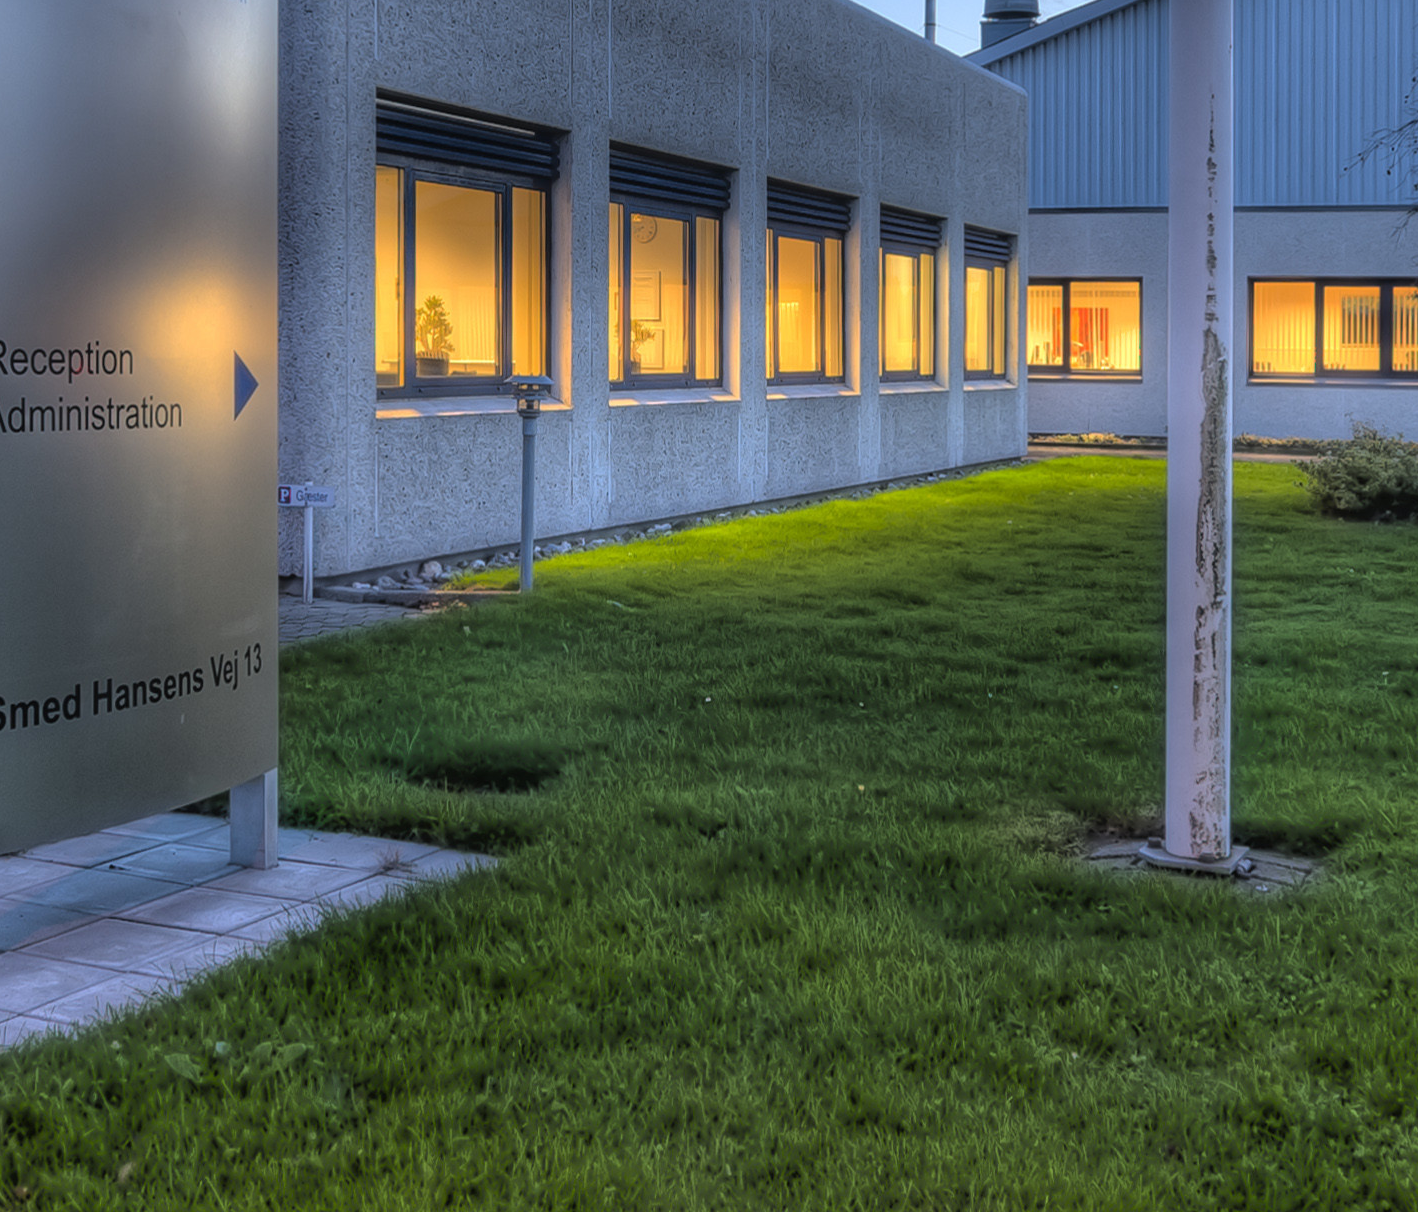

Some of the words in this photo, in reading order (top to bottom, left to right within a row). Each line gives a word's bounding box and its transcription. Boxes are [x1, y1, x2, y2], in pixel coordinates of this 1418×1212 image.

[92, 668, 204, 716] Hansens
[210, 650, 238, 690] Vej
[244, 642, 262, 677] 13
